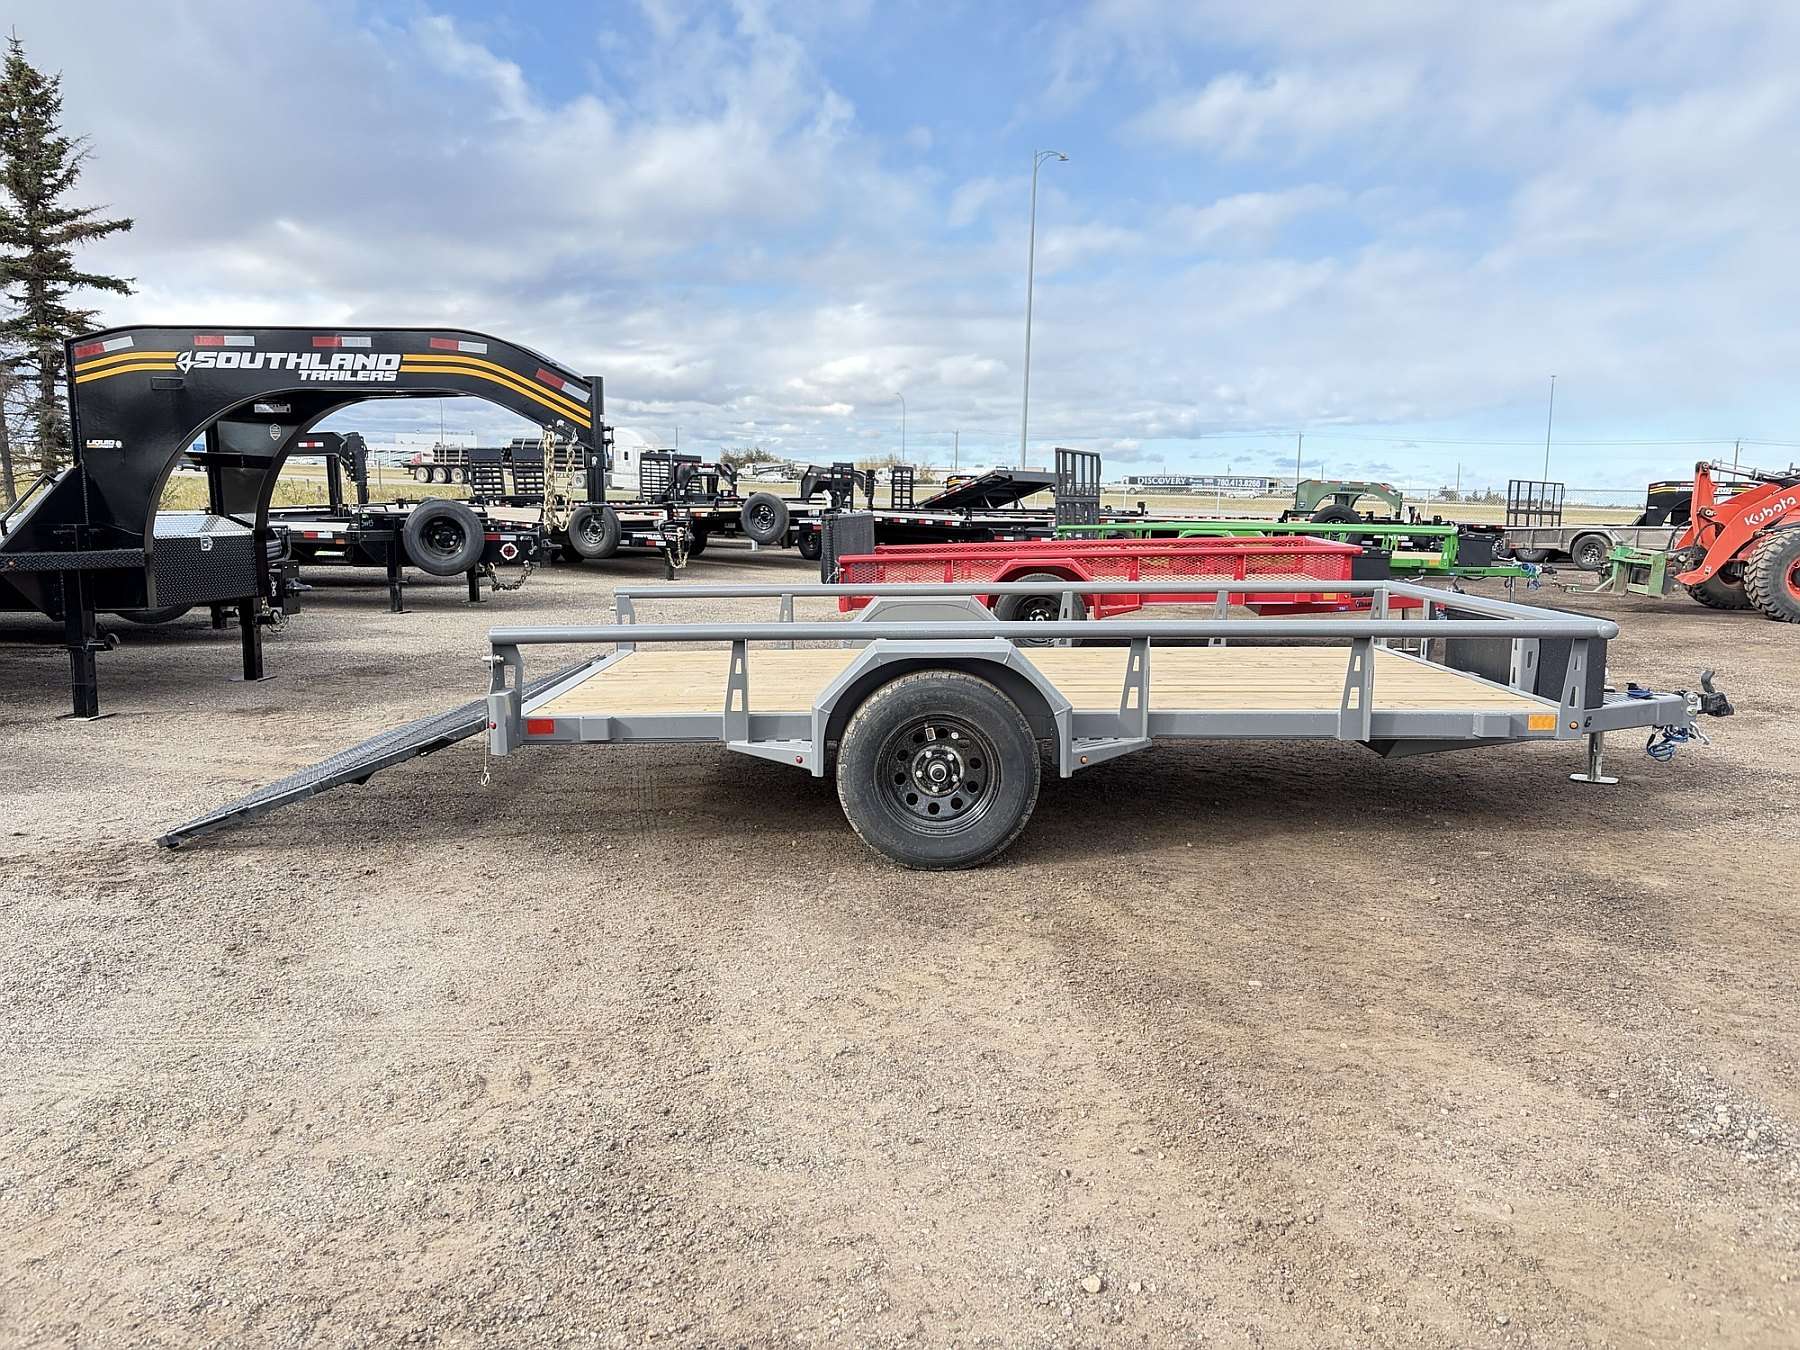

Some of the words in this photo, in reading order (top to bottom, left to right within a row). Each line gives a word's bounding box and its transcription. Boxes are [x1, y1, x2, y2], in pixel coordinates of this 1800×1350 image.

[194, 351, 401, 370] SOUTHLAND
[298, 370, 398, 381] TRAILERS
[1137, 476, 1187, 486] DISCOVERY
[1744, 496, 1797, 526] Kubota
[1584, 715, 1592, 728] C
